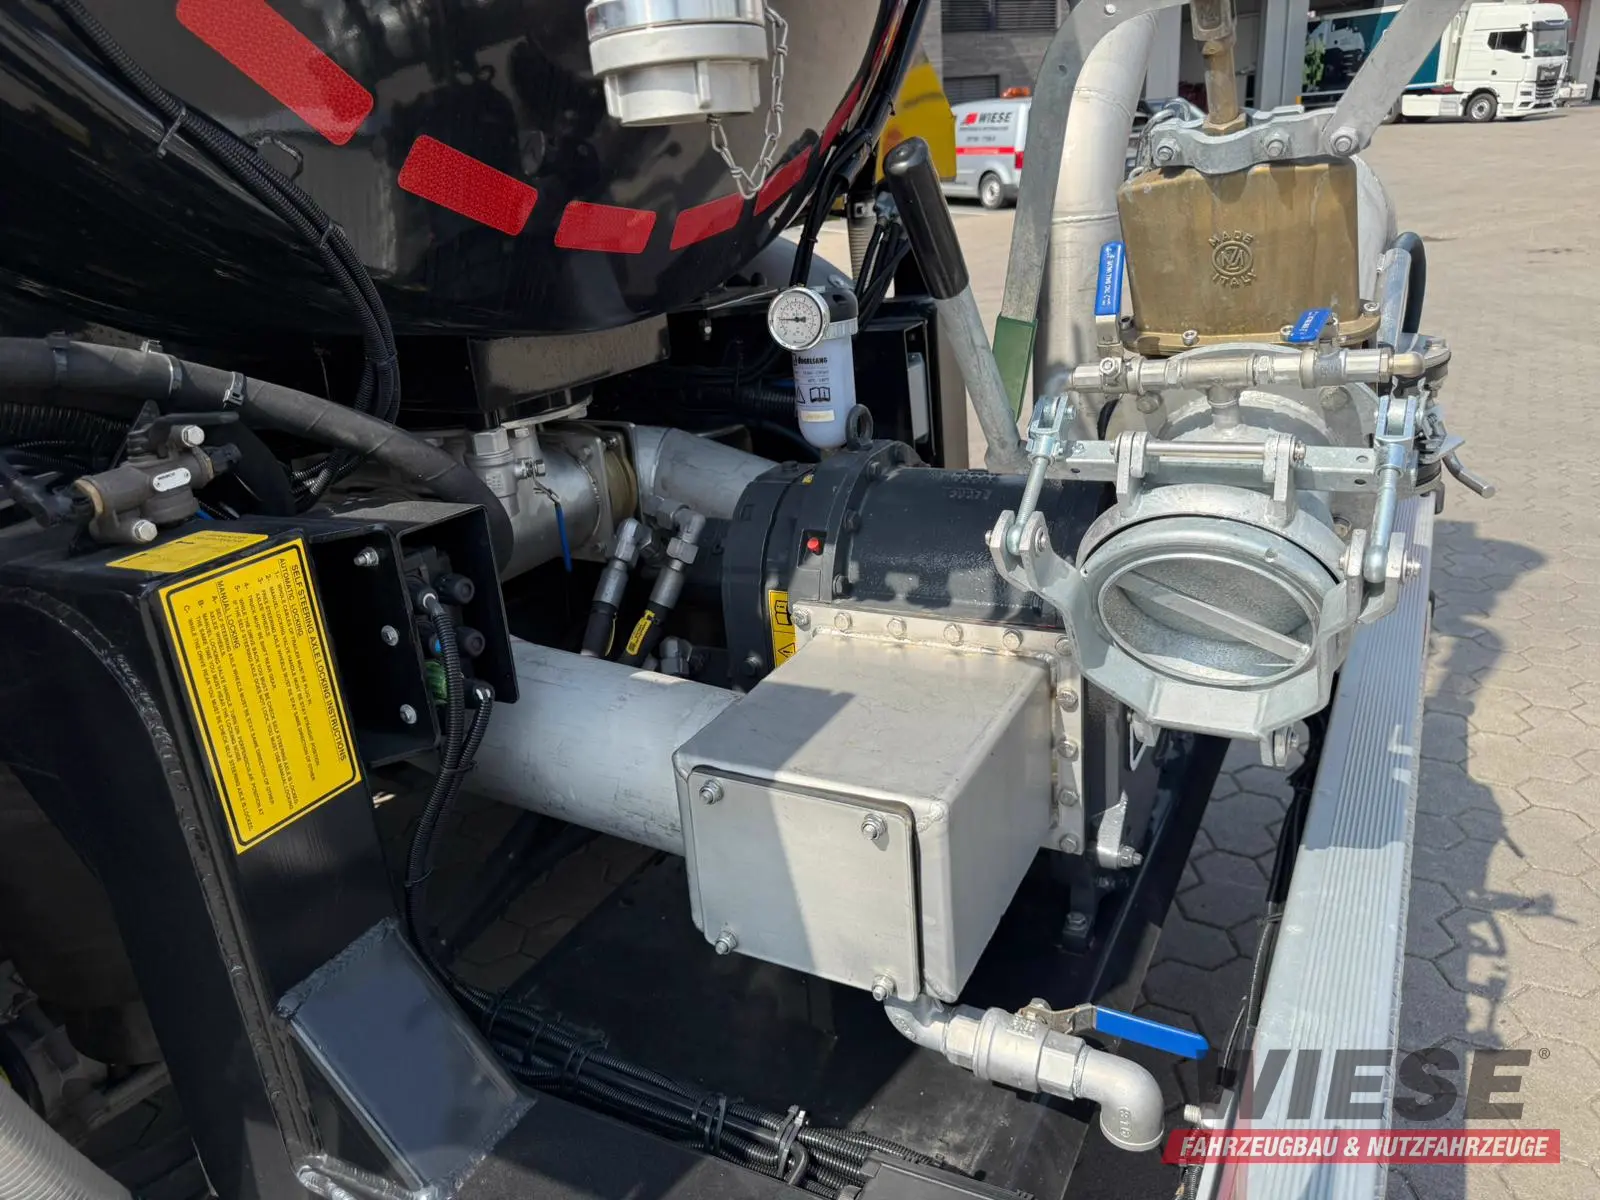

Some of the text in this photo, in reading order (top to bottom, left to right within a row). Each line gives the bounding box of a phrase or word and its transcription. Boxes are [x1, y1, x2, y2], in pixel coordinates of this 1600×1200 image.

[979, 112, 1012, 123] WIESE
[1208, 230, 1254, 247] MADE
[1212, 268, 1257, 287] ITALY
[216, 580, 240, 649] MANUAL LOCKING
[279, 557, 303, 636] AUTOMATIC LOCKING
[291, 563, 346, 761] SELF STEERING AXLE LOCKING INSTRUCTIONS
